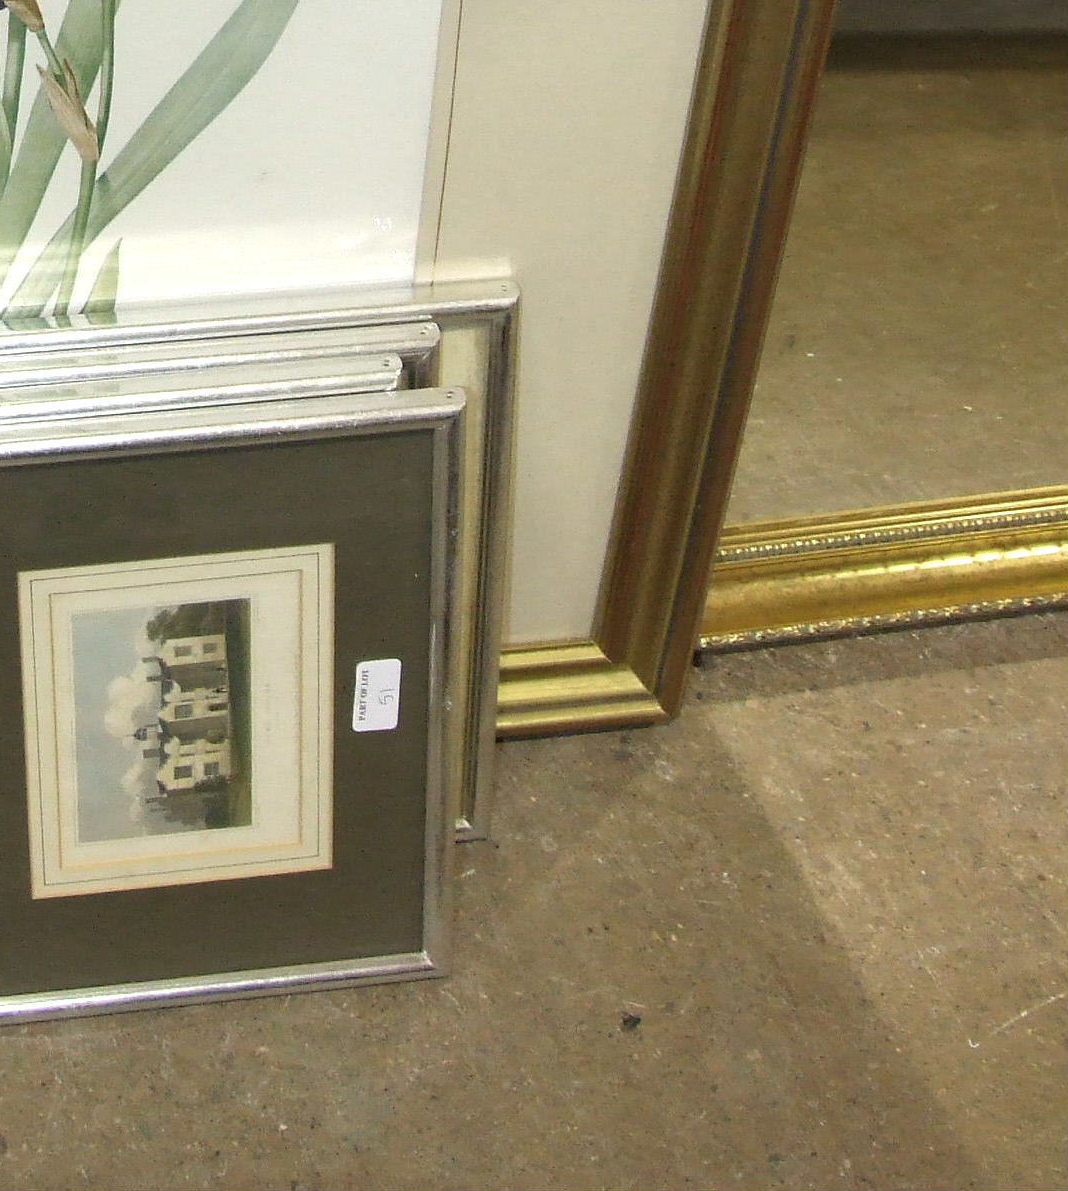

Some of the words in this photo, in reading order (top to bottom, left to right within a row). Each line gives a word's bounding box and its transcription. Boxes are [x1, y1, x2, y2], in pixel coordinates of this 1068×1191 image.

[361, 670, 369, 685] LOT
[361, 688, 367, 698] OF
[379, 688, 396, 705] 51
